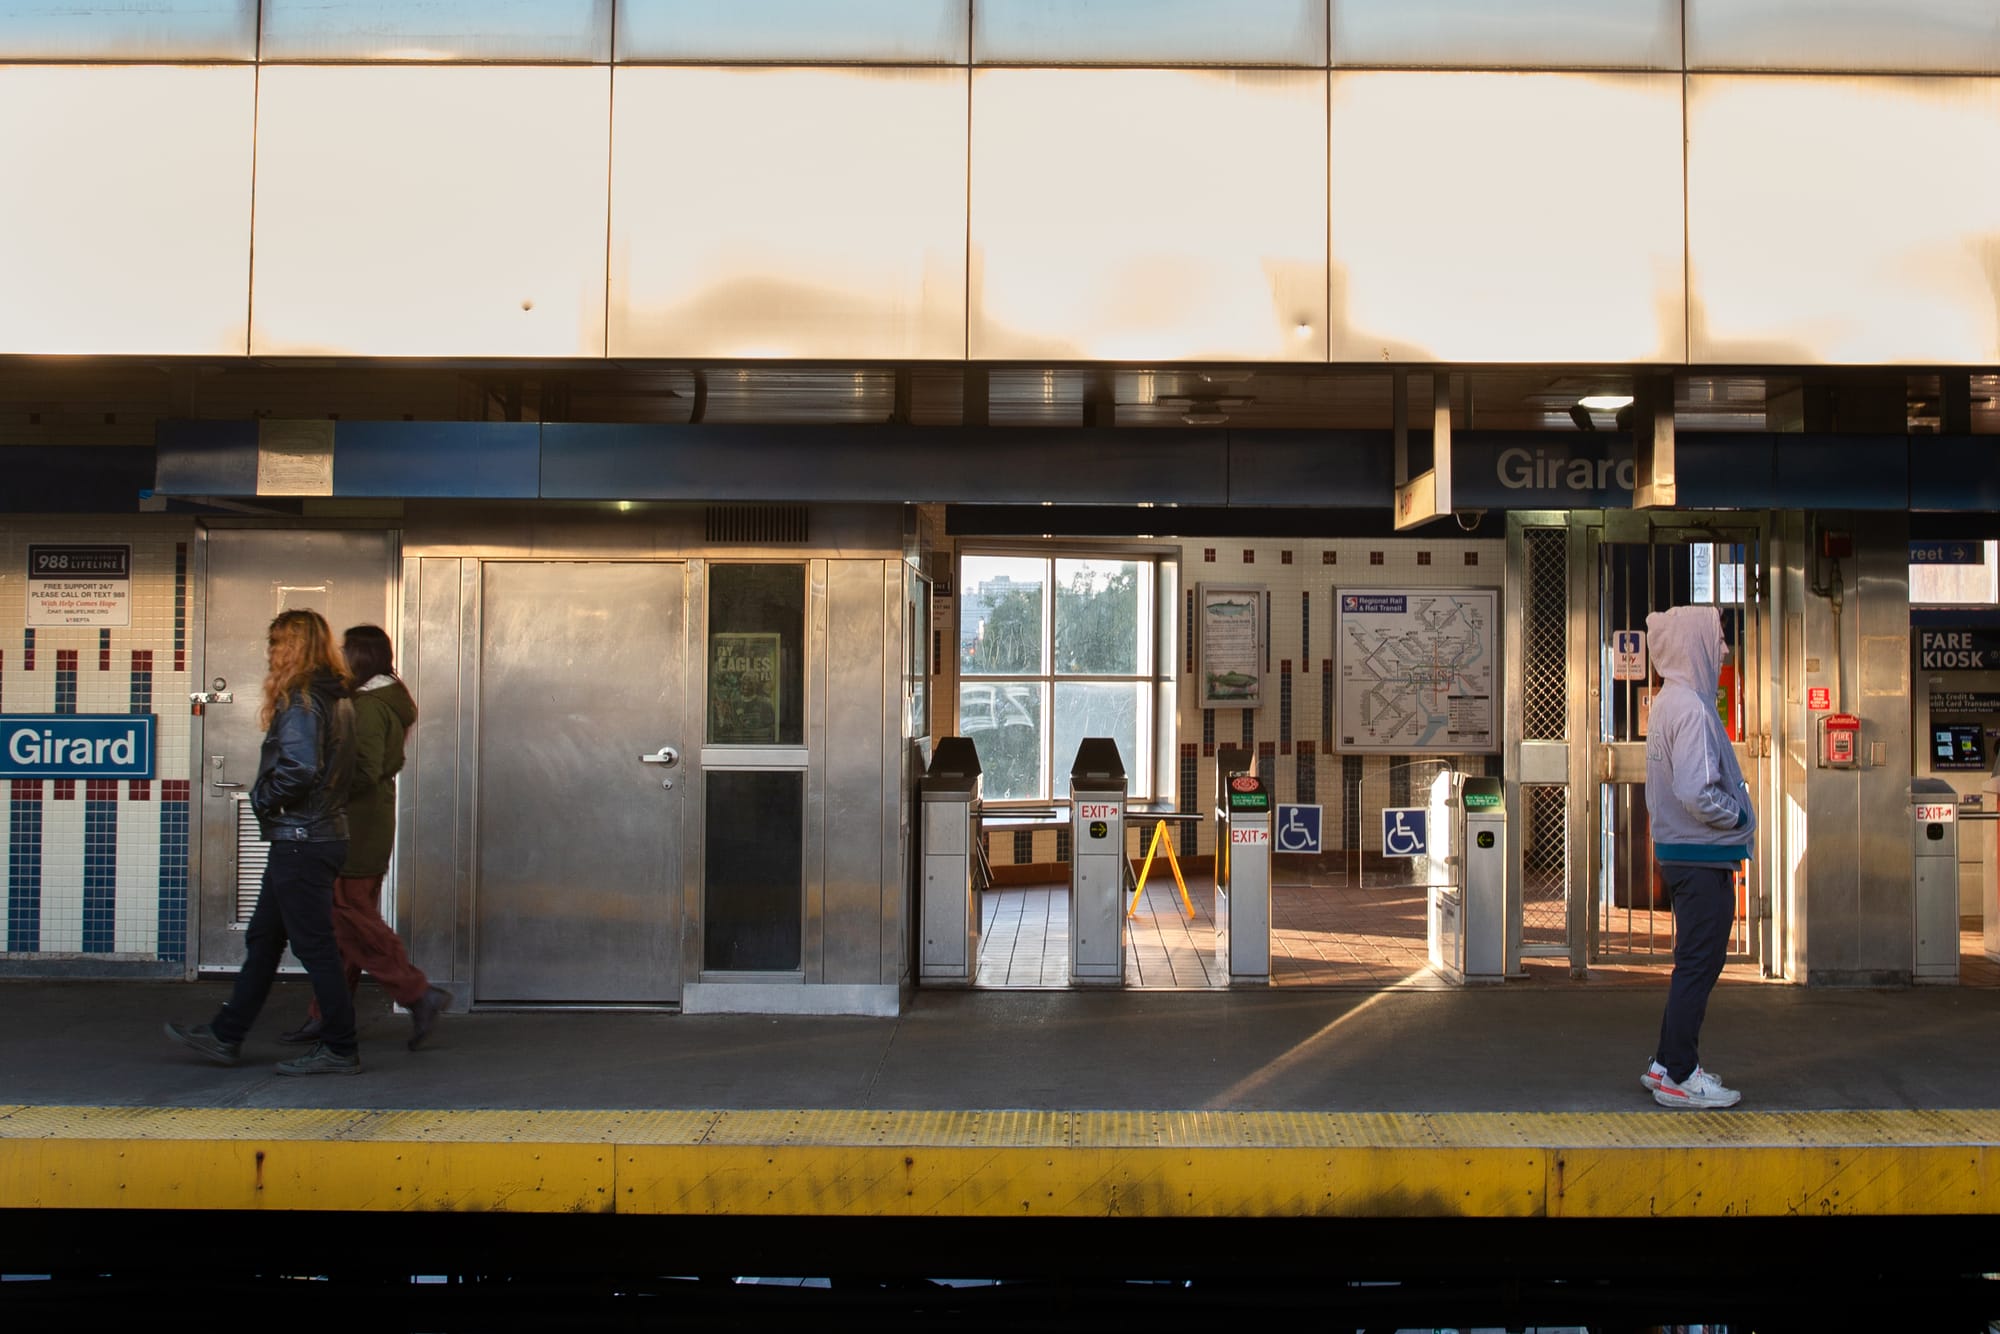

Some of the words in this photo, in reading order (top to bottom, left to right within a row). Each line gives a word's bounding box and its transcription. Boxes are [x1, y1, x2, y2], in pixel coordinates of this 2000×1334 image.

[39, 555, 69, 569] 988
[71, 561, 117, 569] LIFELINE
[59, 600, 75, 609] Help
[99, 600, 117, 609] Hope
[1359, 597, 1389, 605] Regional
[1922, 632, 1973, 650] FARE
[718, 656, 771, 672] EAGLES
[1922, 650, 1985, 669] KIOSK
[9, 728, 136, 766] Girard
[1081, 804, 1109, 819] EXIT
[1916, 806, 1944, 820] EXIT
[1231, 829, 1259, 843] EXIT
